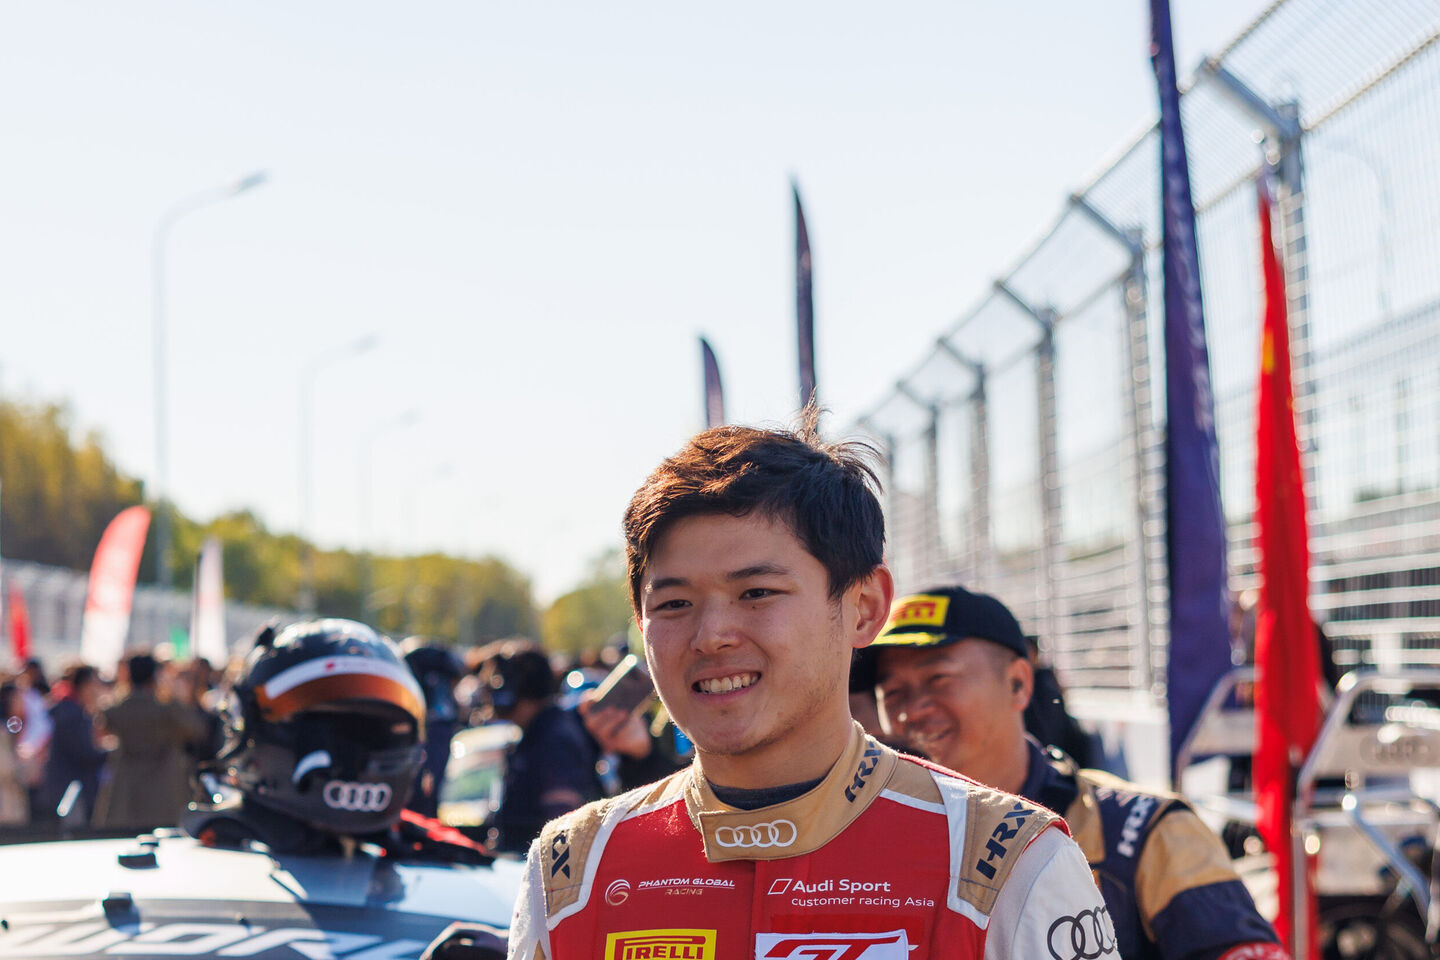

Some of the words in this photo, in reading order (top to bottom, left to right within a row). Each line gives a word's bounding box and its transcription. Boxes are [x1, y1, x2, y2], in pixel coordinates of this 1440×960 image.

[845, 741, 882, 803] HRX
[976, 802, 1036, 880] HRX
[638, 877, 690, 888] PHANTOM
[692, 877, 736, 888] GLOBAL
[792, 880, 834, 893] Audi
[839, 879, 891, 894] Sport
[665, 888, 703, 896] RACING
[791, 896, 855, 907] customer
[859, 896, 900, 908] racing
[905, 897, 935, 907] Asia
